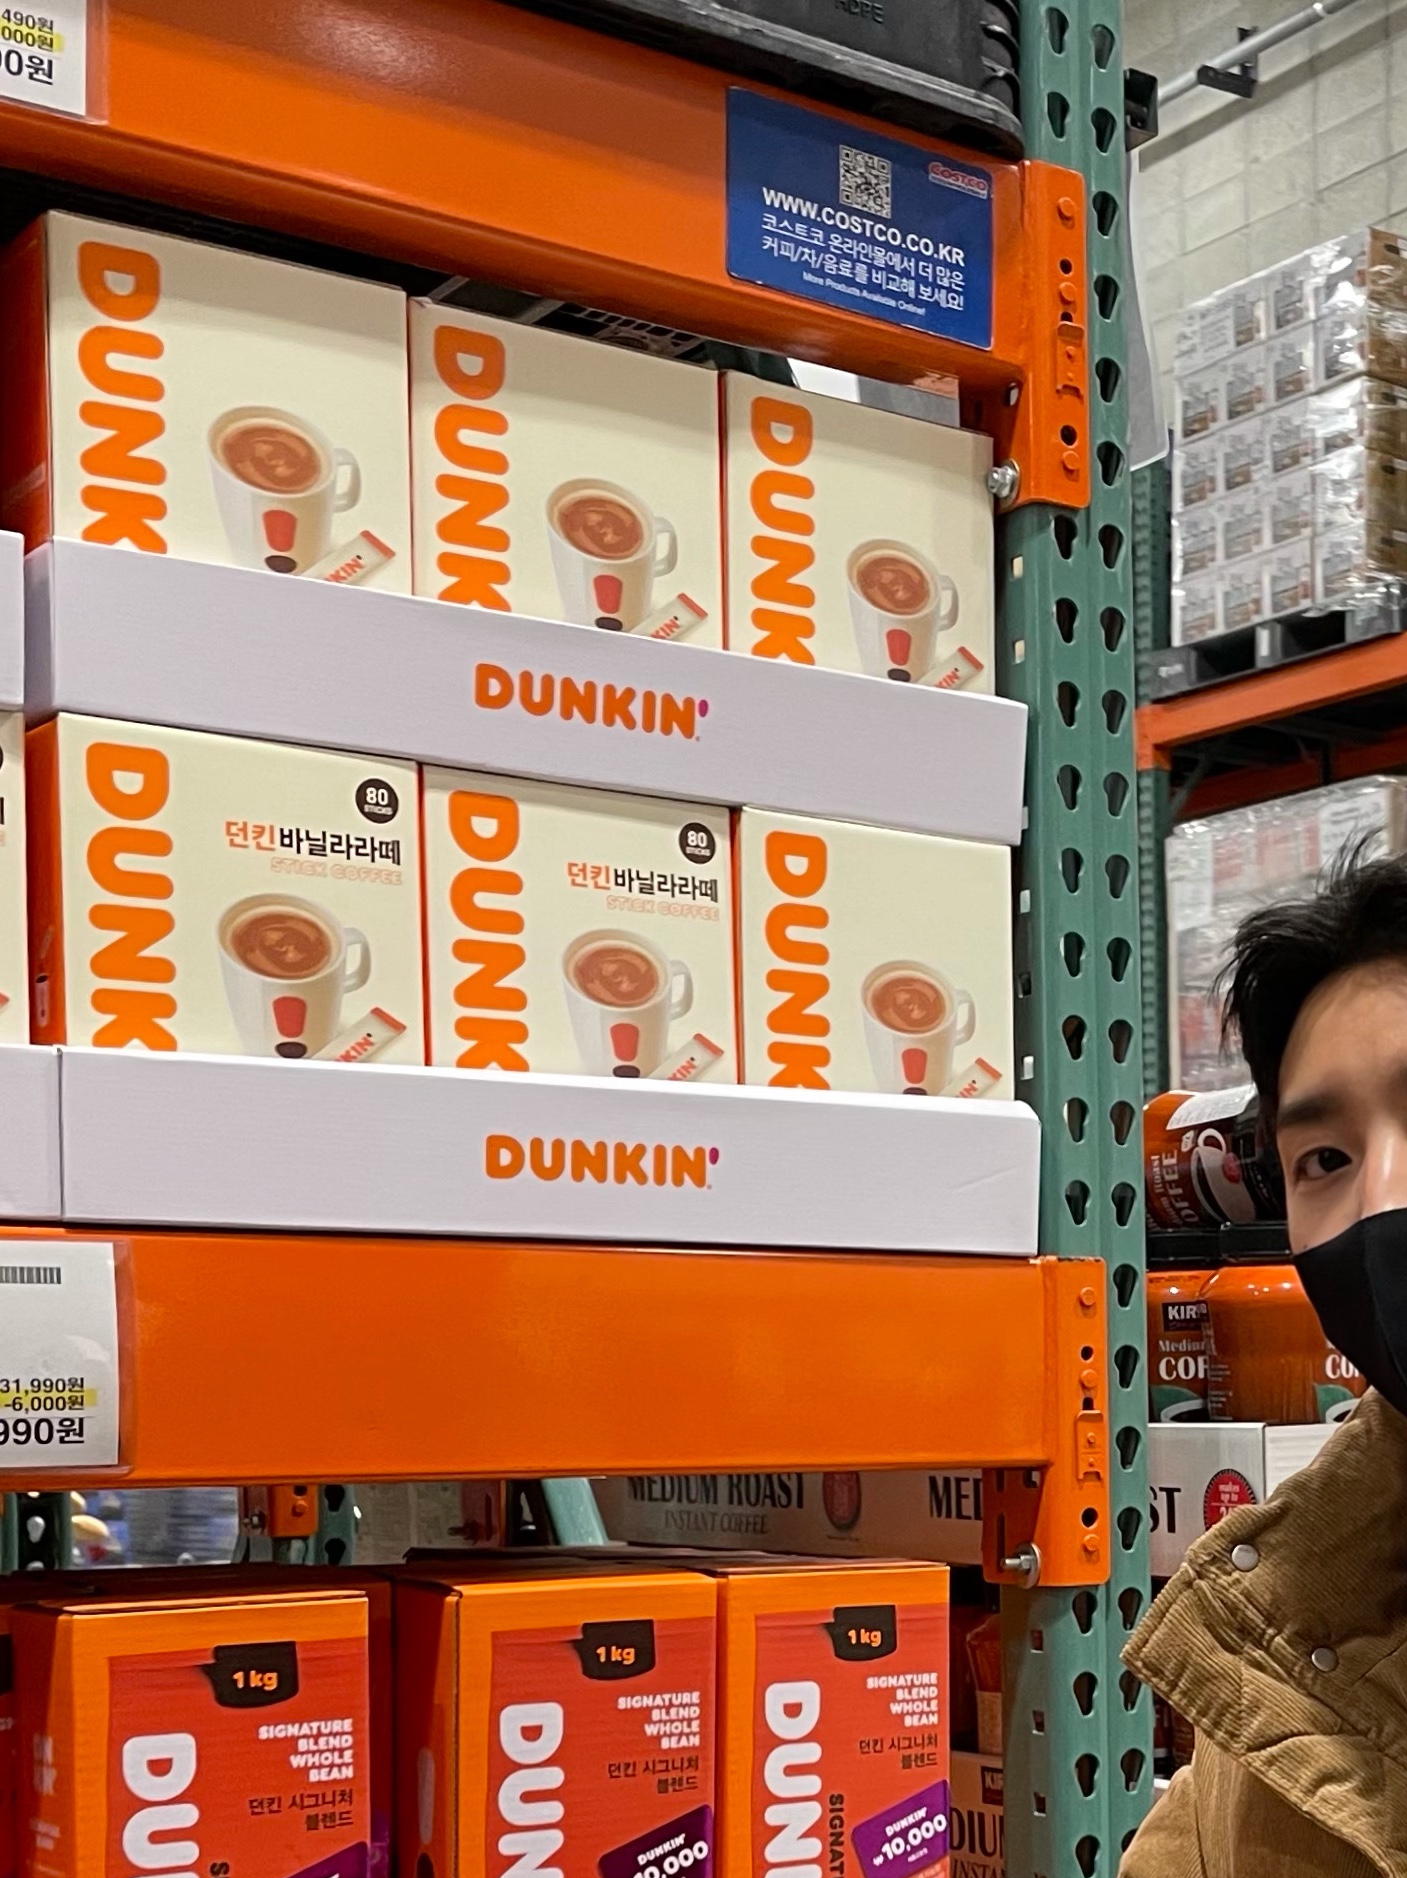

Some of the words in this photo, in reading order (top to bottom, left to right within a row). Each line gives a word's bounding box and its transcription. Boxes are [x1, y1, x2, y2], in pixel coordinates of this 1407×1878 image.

[762, 187, 965, 267] WWW.COSTCO.CO.KR
[762, 213, 826, 246] 코스트코
[828, 233, 916, 277] 온라인몰에서
[918, 262, 933, 281] 더
[935, 266, 965, 292] 많은
[871, 269, 916, 300] 비교해
[918, 282, 965, 311] 보세요!
[474, 663, 709, 742] DUNKIN'
[366, 787, 389, 806] 80
[687, 830, 708, 848] 80
[271, 856, 328, 878] STICK
[330, 863, 403, 886] COFFEE
[605, 895, 657, 914] STICK
[657, 900, 720, 922] COFFEE
[485, 1133, 720, 1190] DUNKIN'
[0, 1377, 84, 1397] 31,990원
[848, 1629, 857, 1645] 1
[860, 1628, 882, 1648] kg
[596, 1646, 606, 1663] 1
[611, 1645, 635, 1665] kg
[233, 1671, 245, 1689] 1
[250, 1669, 278, 1691] kg
[866, 1672, 938, 1690] SIGNATURE
[617, 1691, 700, 1710] SIGNATURE
[896, 1686, 938, 1701] BLEND
[651, 1706, 700, 1722] BLEND
[889, 1699, 939, 1715] WHOLE
[258, 1718, 353, 1740] SIGNATURE
[644, 1719, 700, 1737] WHOLE
[904, 1712, 939, 1728] BEAN
[298, 1734, 353, 1752] BLEND
[661, 1734, 700, 1750] BEAN
[289, 1750, 353, 1769] WHOLE
[309, 1765, 354, 1783] BEAN
